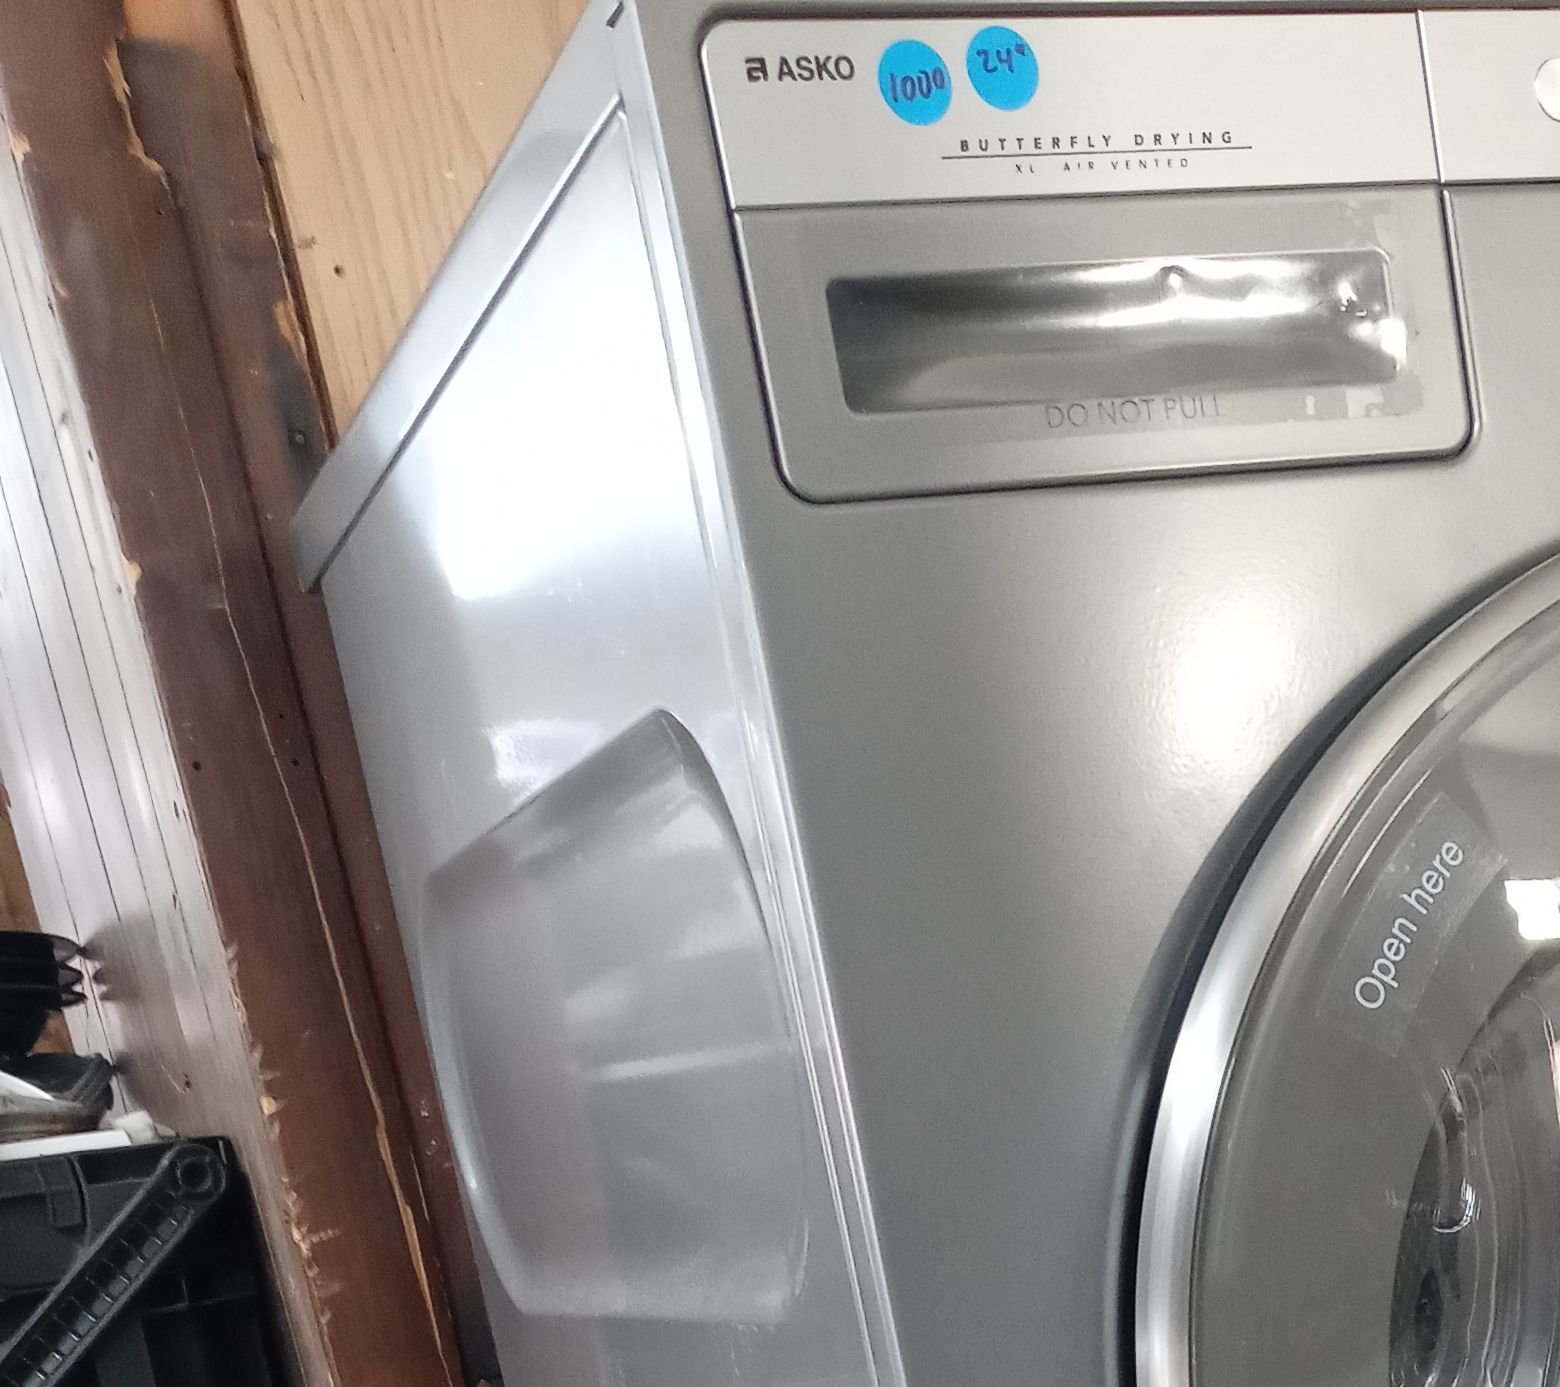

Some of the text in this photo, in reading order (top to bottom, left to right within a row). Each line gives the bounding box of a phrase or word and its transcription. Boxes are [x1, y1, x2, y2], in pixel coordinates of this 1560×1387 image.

[777, 55, 855, 82] ASKO
[960, 131, 1233, 153] BUTTERFLY DRYING
[1015, 158, 1189, 174] XL AIR VENTED
[1046, 394, 1228, 429] DO NOT PULL
[1354, 841, 1464, 1009] Open here
